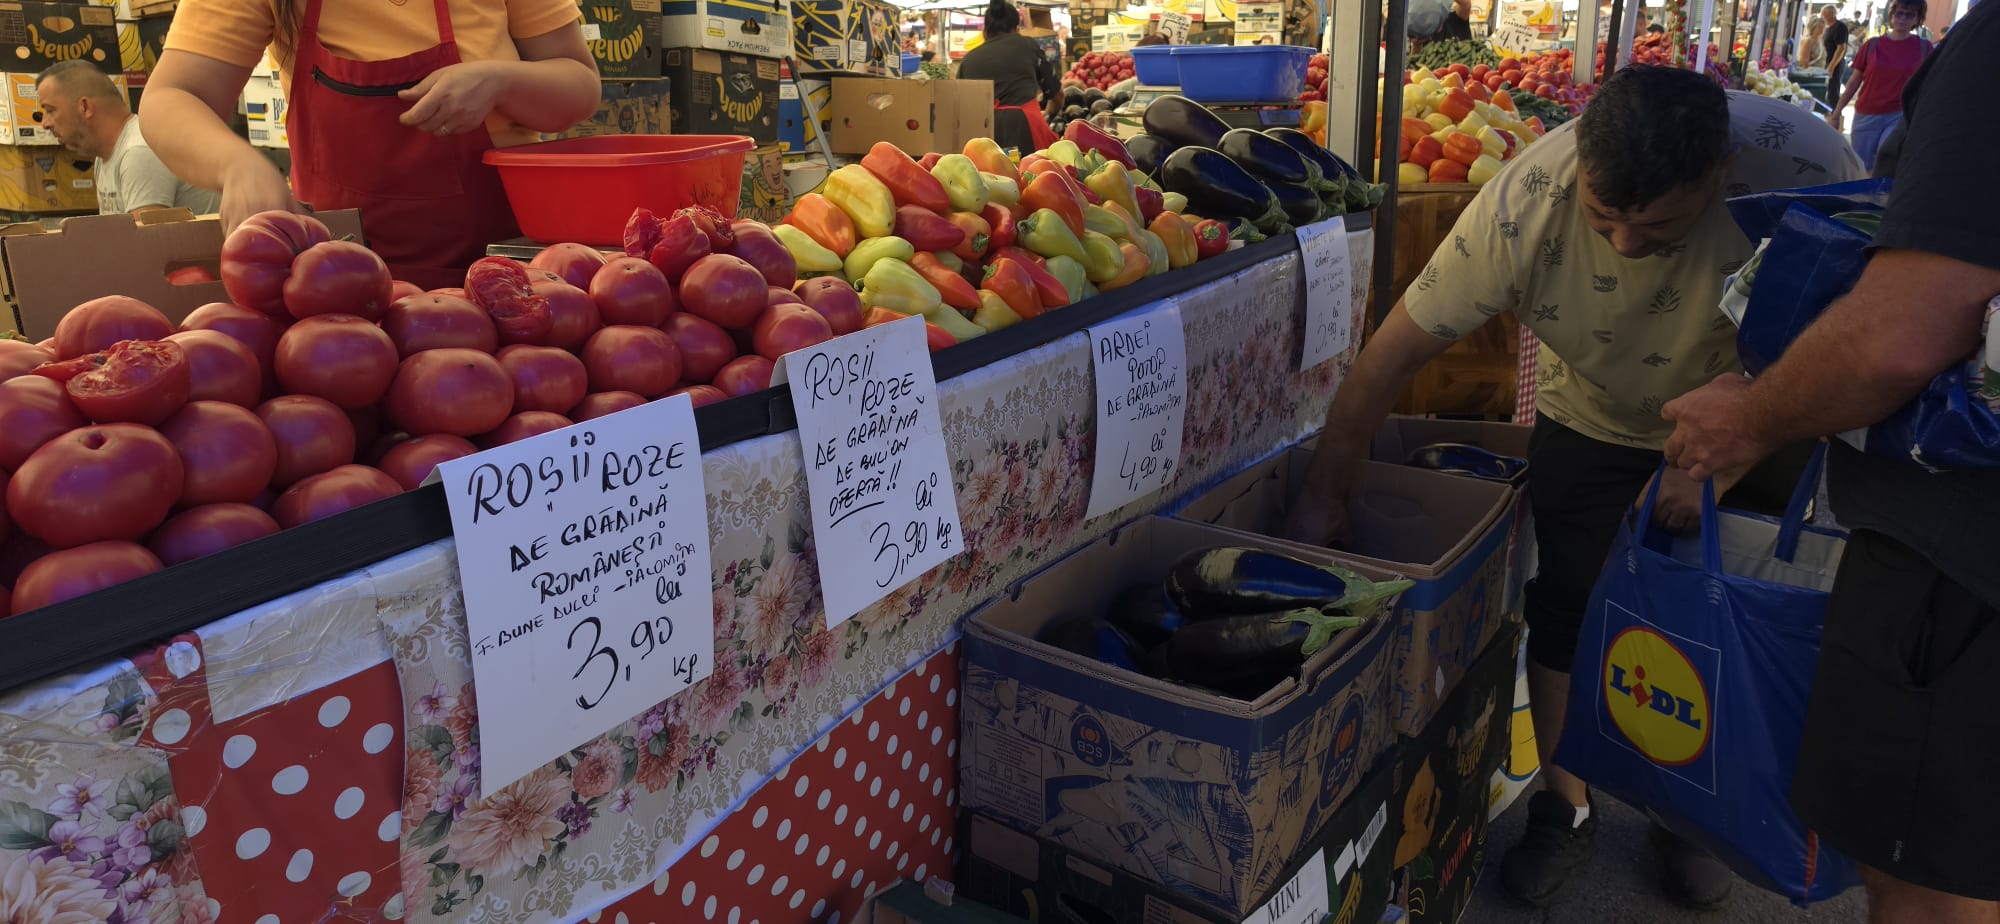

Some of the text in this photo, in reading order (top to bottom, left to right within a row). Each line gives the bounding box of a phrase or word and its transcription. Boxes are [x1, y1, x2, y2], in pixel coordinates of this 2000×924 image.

[1100, 320, 1150, 365] ARDEI
[804, 339, 876, 409] ROȘII
[860, 373, 914, 417] ROZE
[1107, 396, 1122, 418] DE
[816, 437, 836, 471] DE
[837, 436, 909, 486] DE BULION
[1120, 441, 1157, 492] 4,90
[467, 431, 685, 525] ROȘII ROZE
[509, 536, 548, 573] DE
[869, 521, 927, 587] 3,90
[655, 563, 682, 604] lei
[498, 614, 544, 647] BUNE
[567, 616, 674, 709] 3,90
[1267, 876, 1302, 924] MINI
